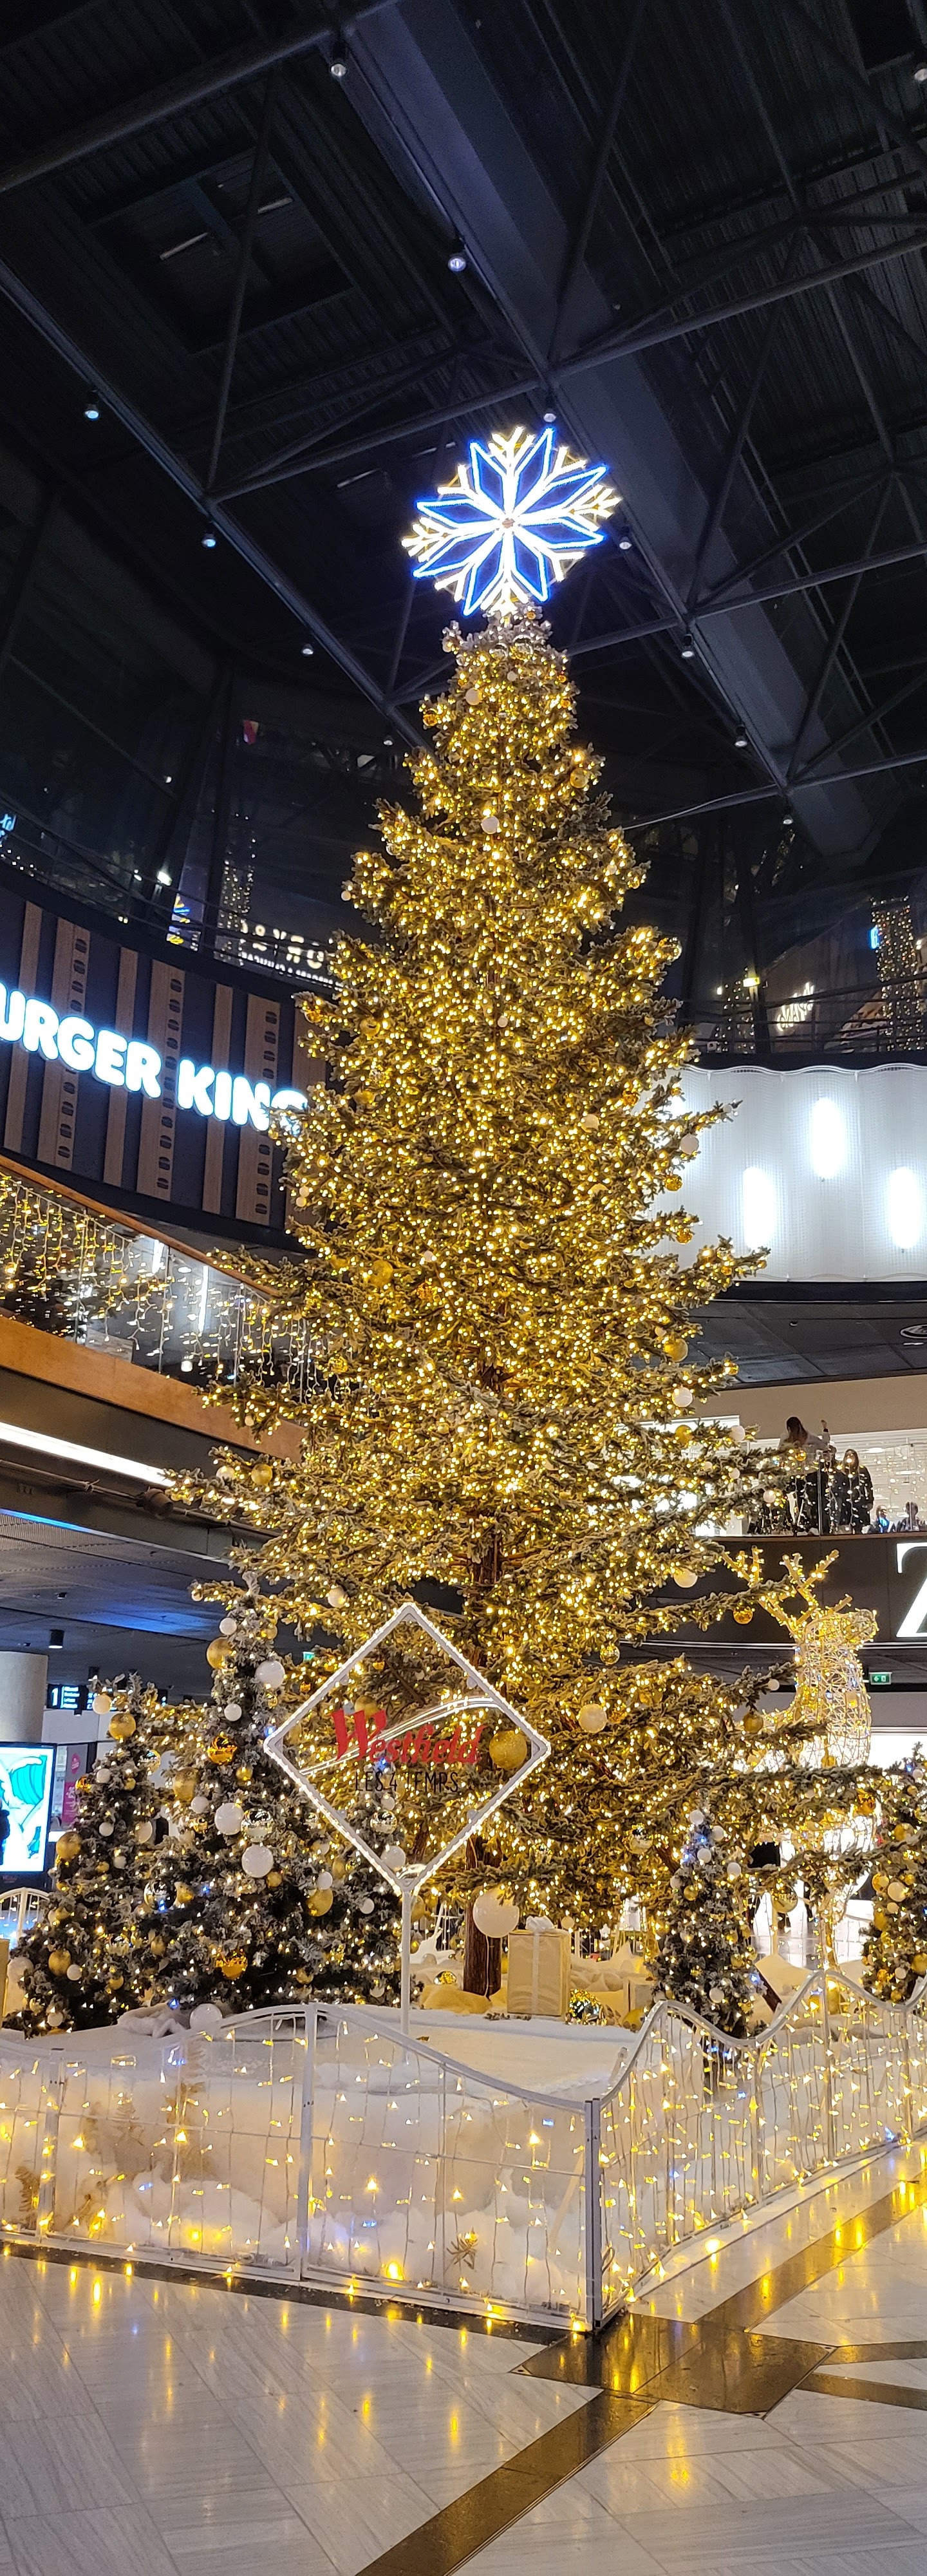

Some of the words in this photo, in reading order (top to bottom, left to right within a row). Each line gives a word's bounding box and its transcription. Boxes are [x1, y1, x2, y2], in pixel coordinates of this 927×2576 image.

[331, 1709, 487, 1764] Westfield
[355, 1770, 384, 1792] LES
[389, 1771, 398, 1792] 4
